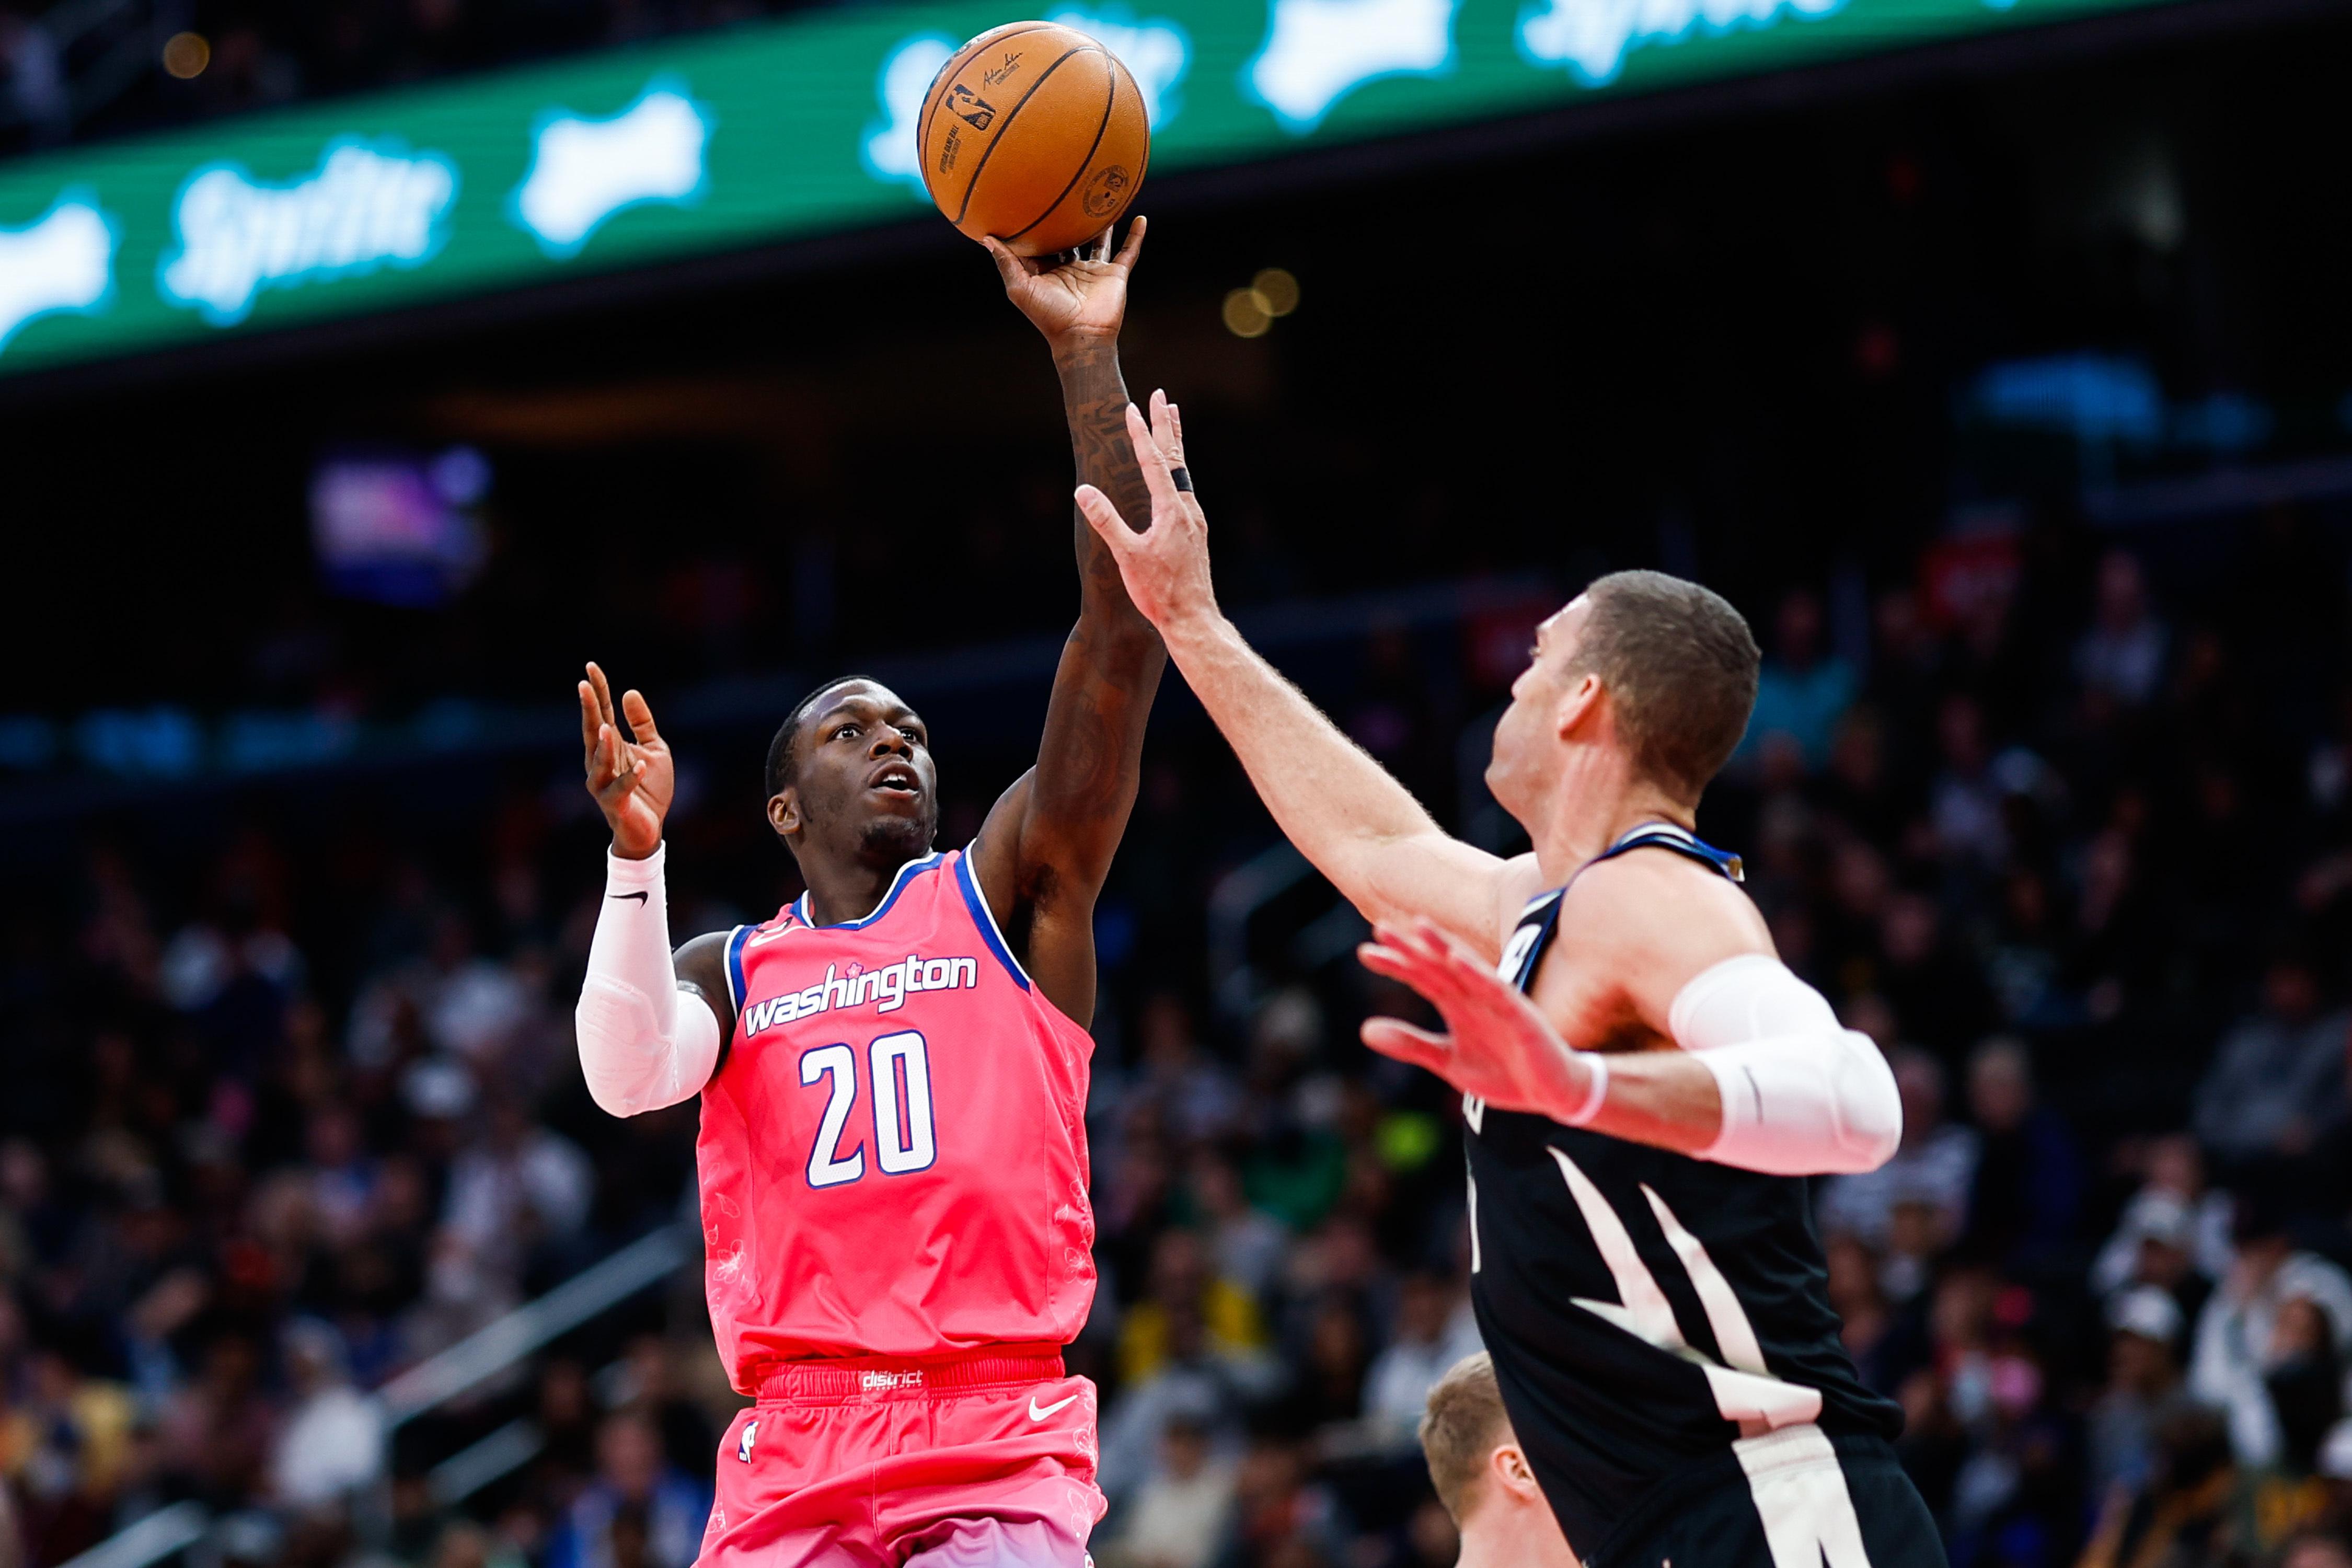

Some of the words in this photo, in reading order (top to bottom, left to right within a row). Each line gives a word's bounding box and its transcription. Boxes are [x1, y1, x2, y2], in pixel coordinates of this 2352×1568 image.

[745, 954, 977, 1037] washington
[799, 1029, 937, 1190] 20
[862, 1369, 924, 1388] district
